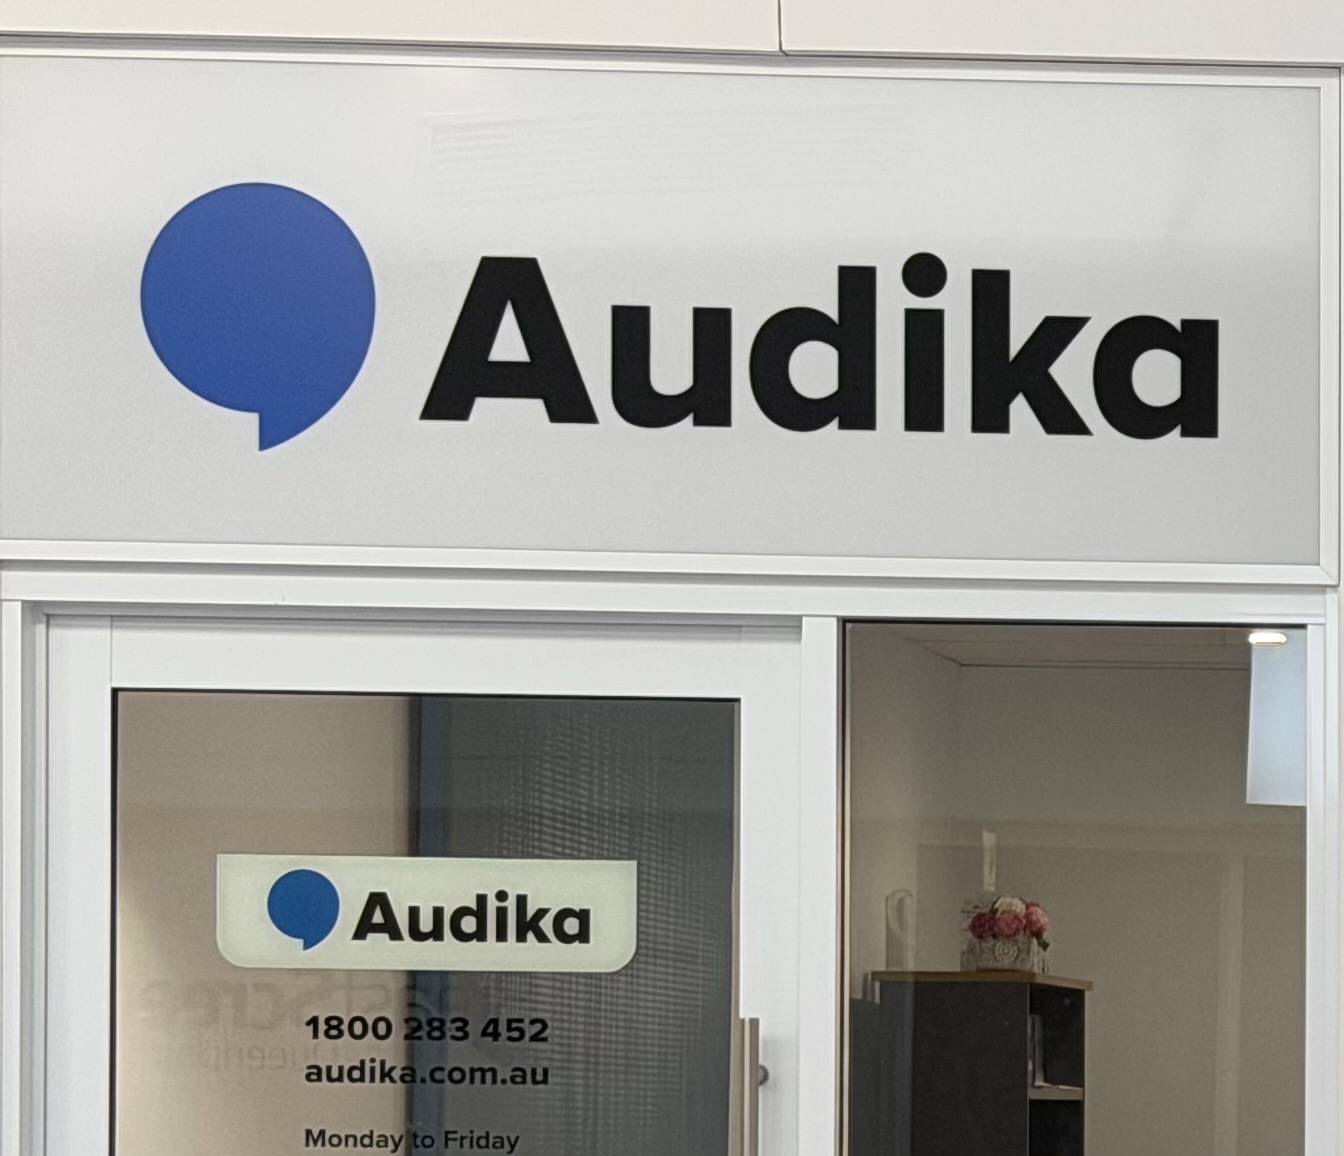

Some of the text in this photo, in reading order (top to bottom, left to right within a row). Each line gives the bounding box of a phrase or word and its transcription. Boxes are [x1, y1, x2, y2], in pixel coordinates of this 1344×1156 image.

[420, 251, 1219, 439] Audika
[351, 890, 591, 944] Audika
[305, 1016, 549, 1042] 1800 283 452
[305, 1058, 549, 1085] audika.com.au
[305, 1128, 520, 1154] Monday to Friday
